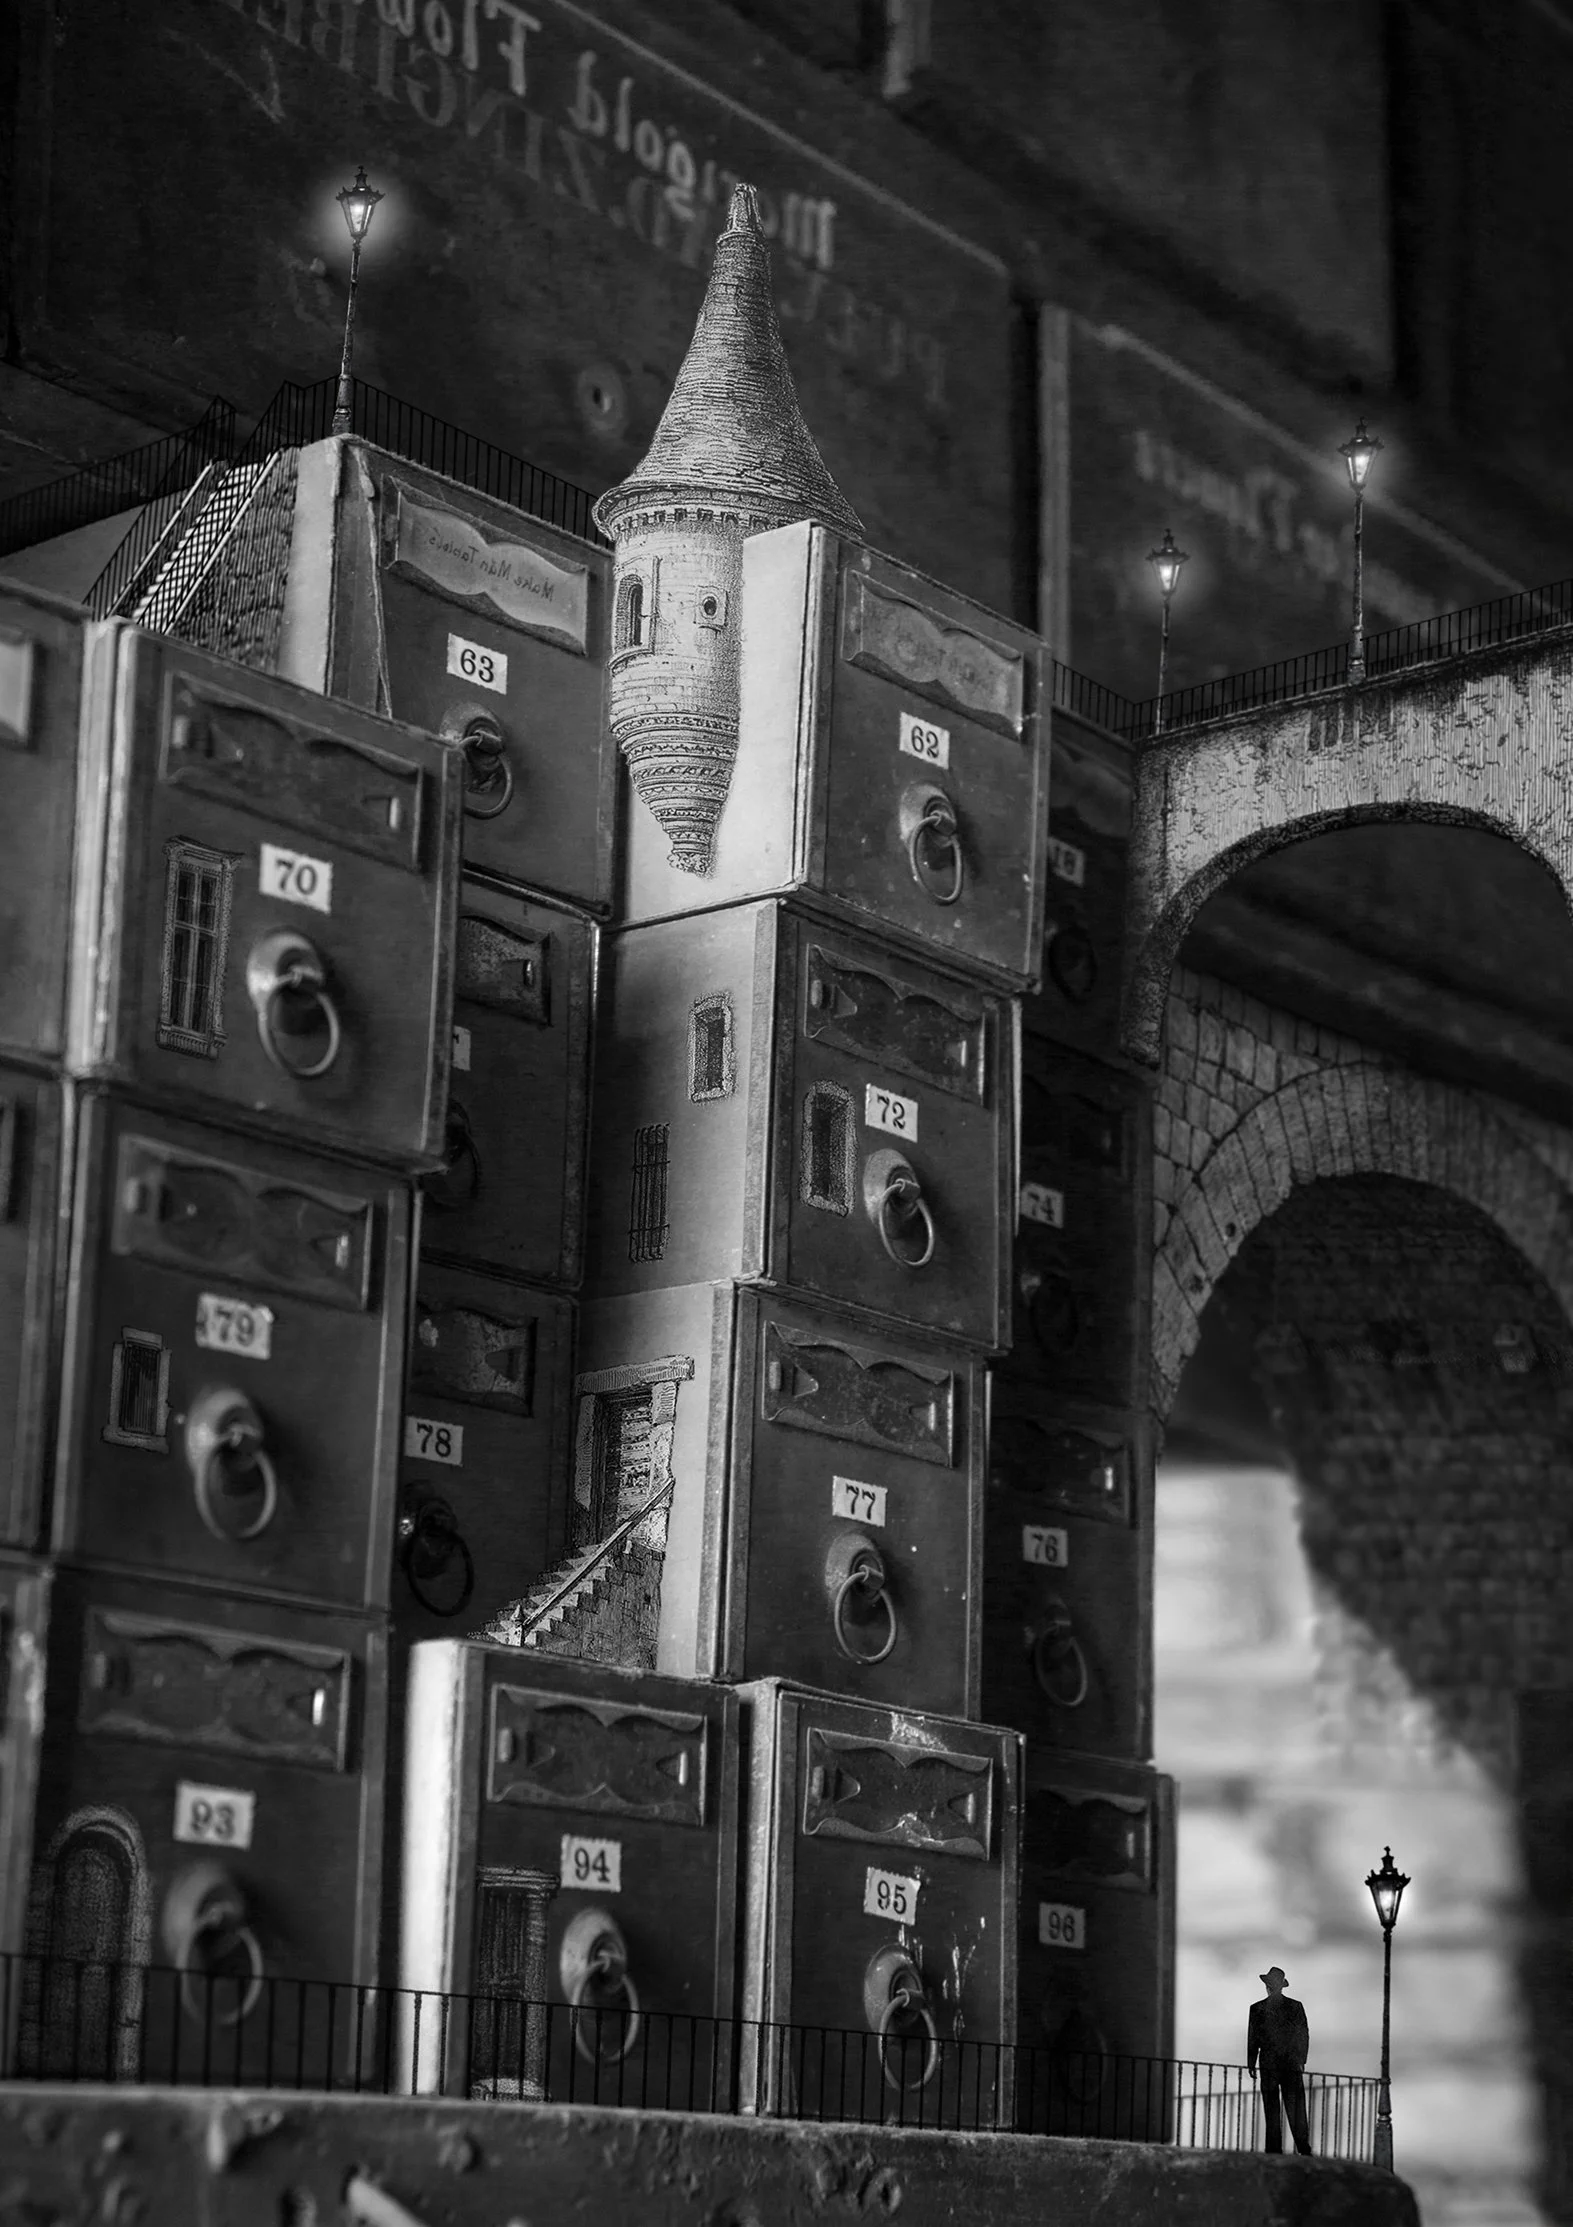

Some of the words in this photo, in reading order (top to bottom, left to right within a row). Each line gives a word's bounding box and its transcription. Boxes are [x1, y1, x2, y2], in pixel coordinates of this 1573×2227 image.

[460, 649, 494, 683] 63
[911, 726, 939, 759] 62
[276, 858, 316, 895] 70
[877, 1095, 905, 1129] 72
[1027, 1191, 1055, 1223] 74
[217, 1309, 254, 1347] 79
[416, 1422, 452, 1458] 78
[846, 1484, 876, 1520] 77
[1031, 1533, 1058, 1563] 76
[192, 1801, 234, 1840] 93
[574, 1847, 610, 1883] 94
[876, 1880, 908, 1915] 95
[1047, 1910, 1076, 1944] 96
